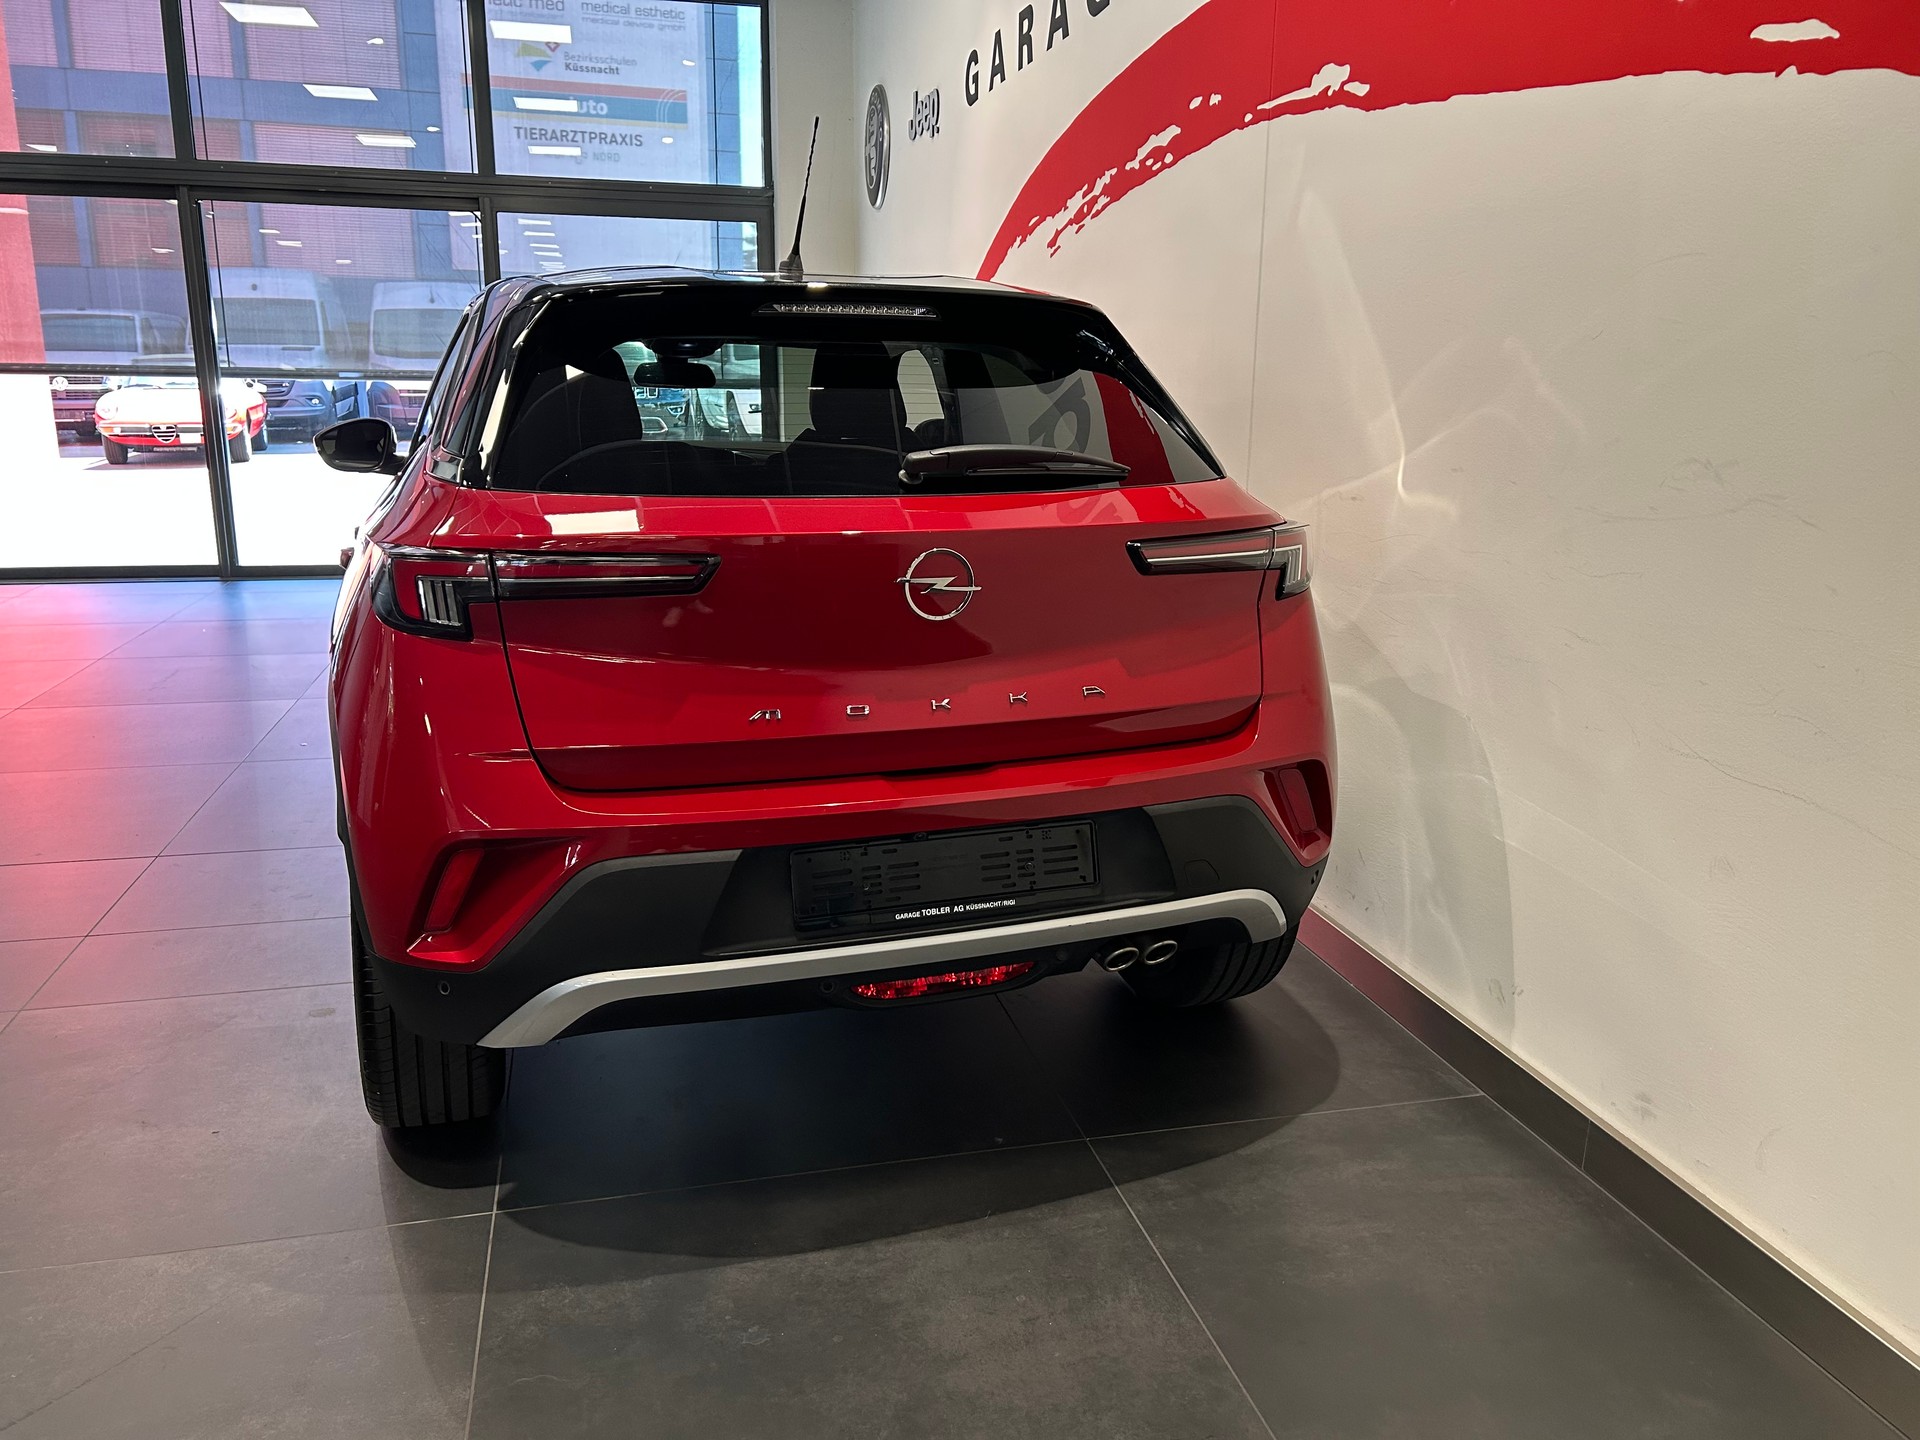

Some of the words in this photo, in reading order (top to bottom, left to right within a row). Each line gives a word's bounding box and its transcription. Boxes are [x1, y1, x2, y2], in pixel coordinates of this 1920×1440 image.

[581, 2, 630, 15] medical
[635, 5, 686, 20] esthetic
[564, 52, 638, 67] Bezirksschulen
[564, 62, 620, 75] Küssnacht
[905, 88, 940, 141] Jeep
[513, 126, 644, 147] TIERARZTPRAXIS
[593, 152, 621, 162] NORD
[749, 685, 1106, 721] MOKKA
[895, 910, 921, 920] GARAGE
[922, 906, 951, 917] TOBLER
[953, 904, 965, 913] AG
[966, 899, 1016, 911] KÜSSNACHT/RIGI
